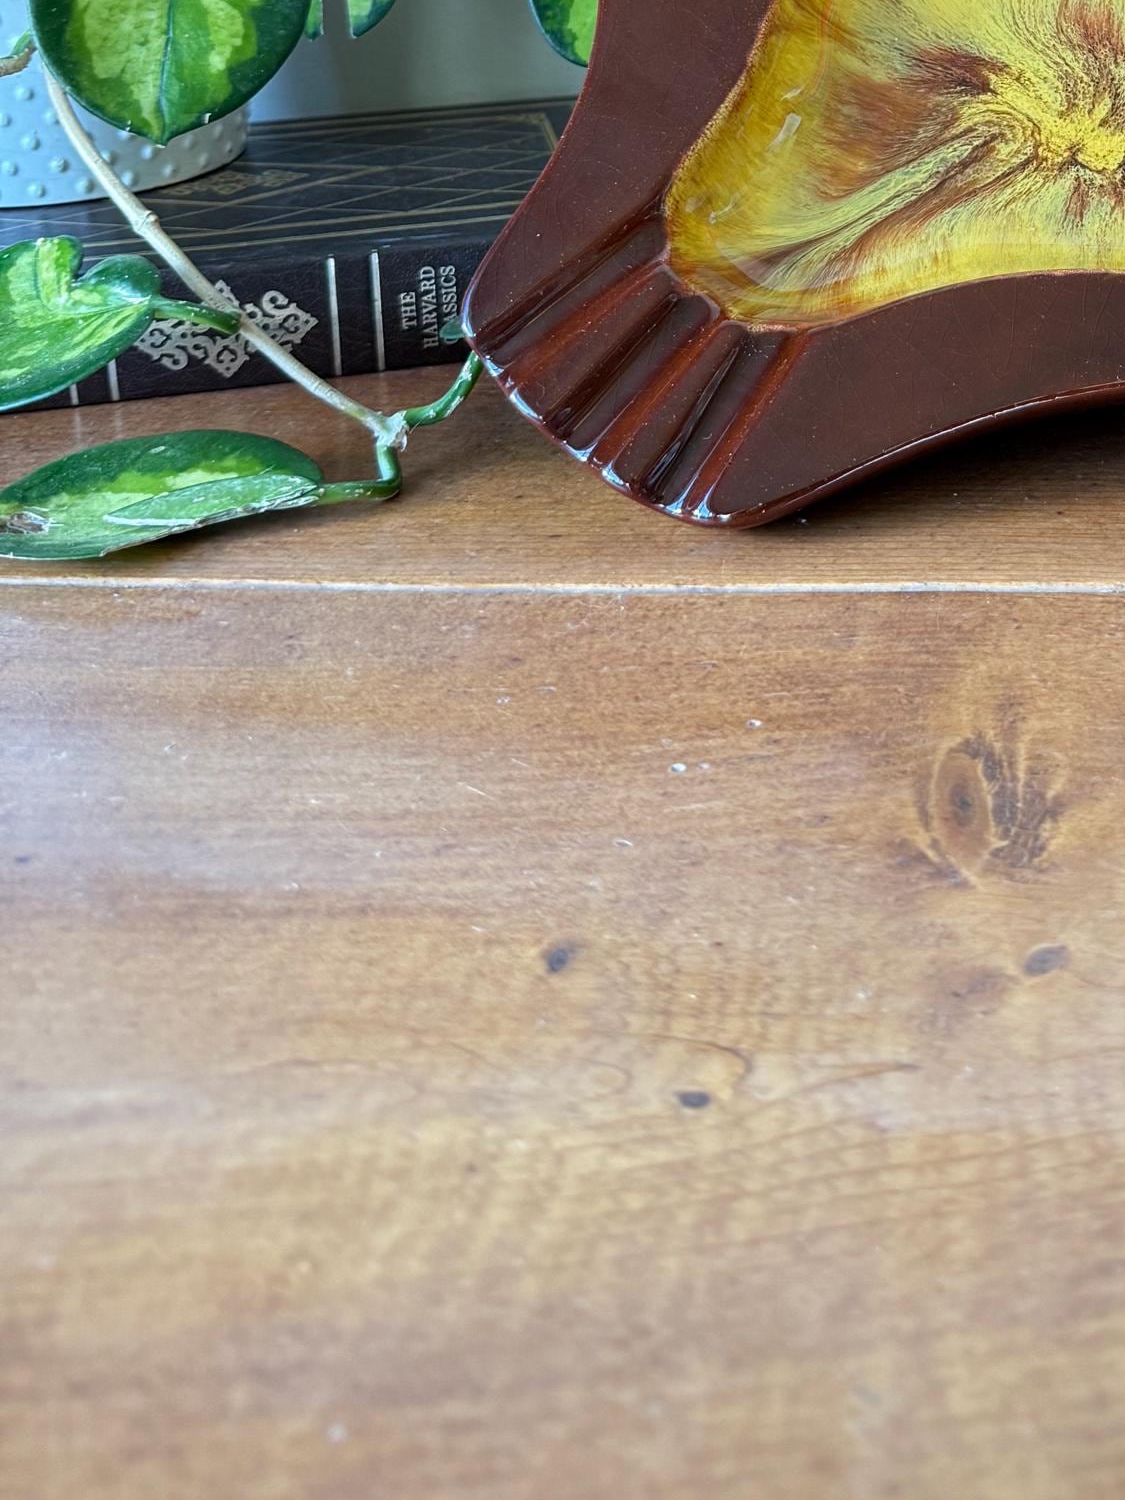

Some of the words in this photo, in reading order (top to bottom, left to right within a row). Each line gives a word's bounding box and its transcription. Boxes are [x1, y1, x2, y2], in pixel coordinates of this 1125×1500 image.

[400, 291, 417, 330] THE
[420, 265, 439, 349] HARVARD
[440, 265, 459, 345] CASSICS
